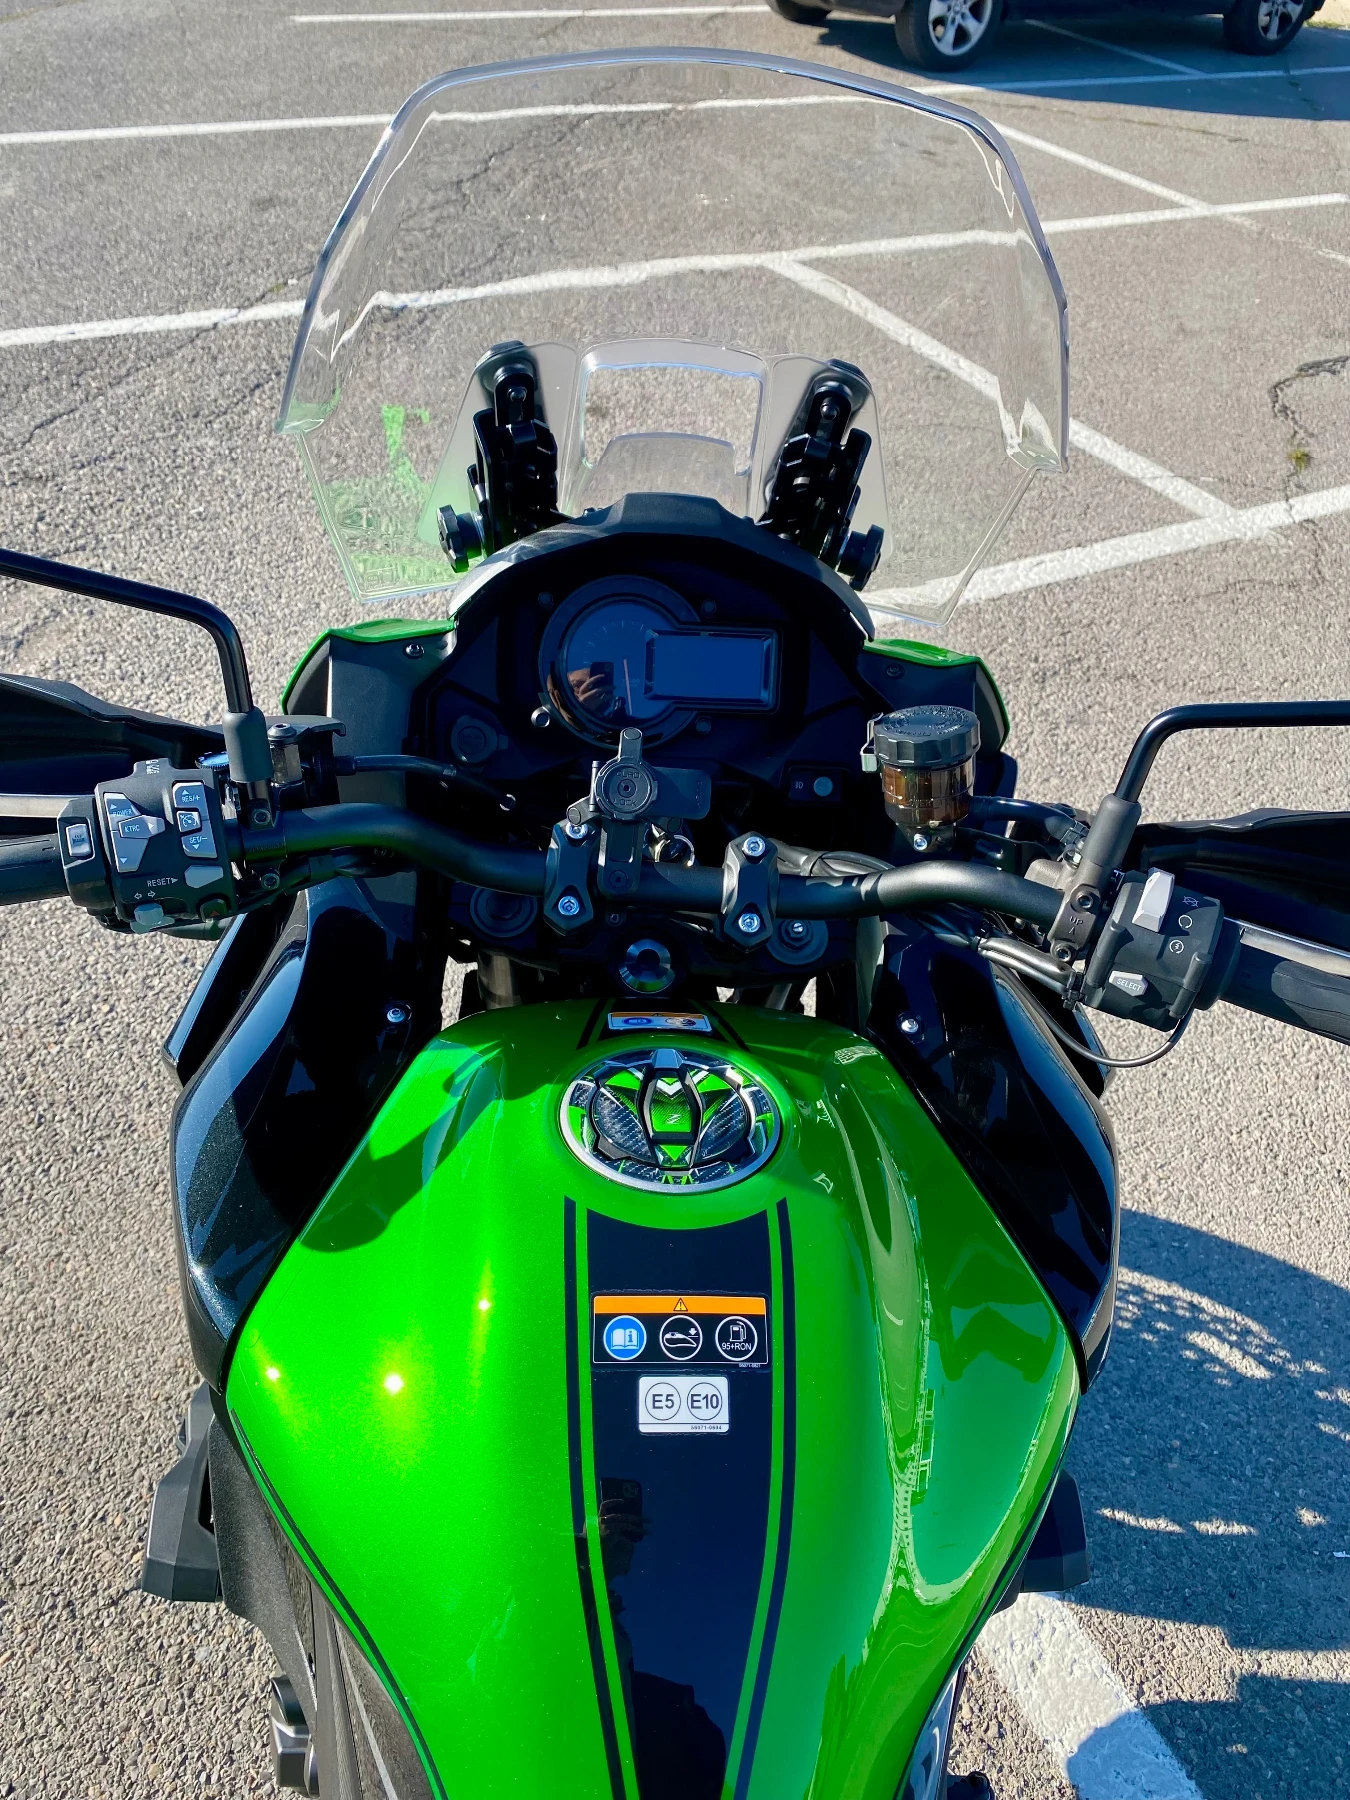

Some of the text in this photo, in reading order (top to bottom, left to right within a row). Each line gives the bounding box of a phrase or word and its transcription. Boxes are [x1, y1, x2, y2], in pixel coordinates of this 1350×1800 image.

[146, 877, 171, 888] RESET
[1069, 915, 1084, 926] UP
[1116, 977, 1142, 992] SELECT
[721, 1342, 752, 1351] 95+RON
[652, 1393, 720, 1410] E5 E10
